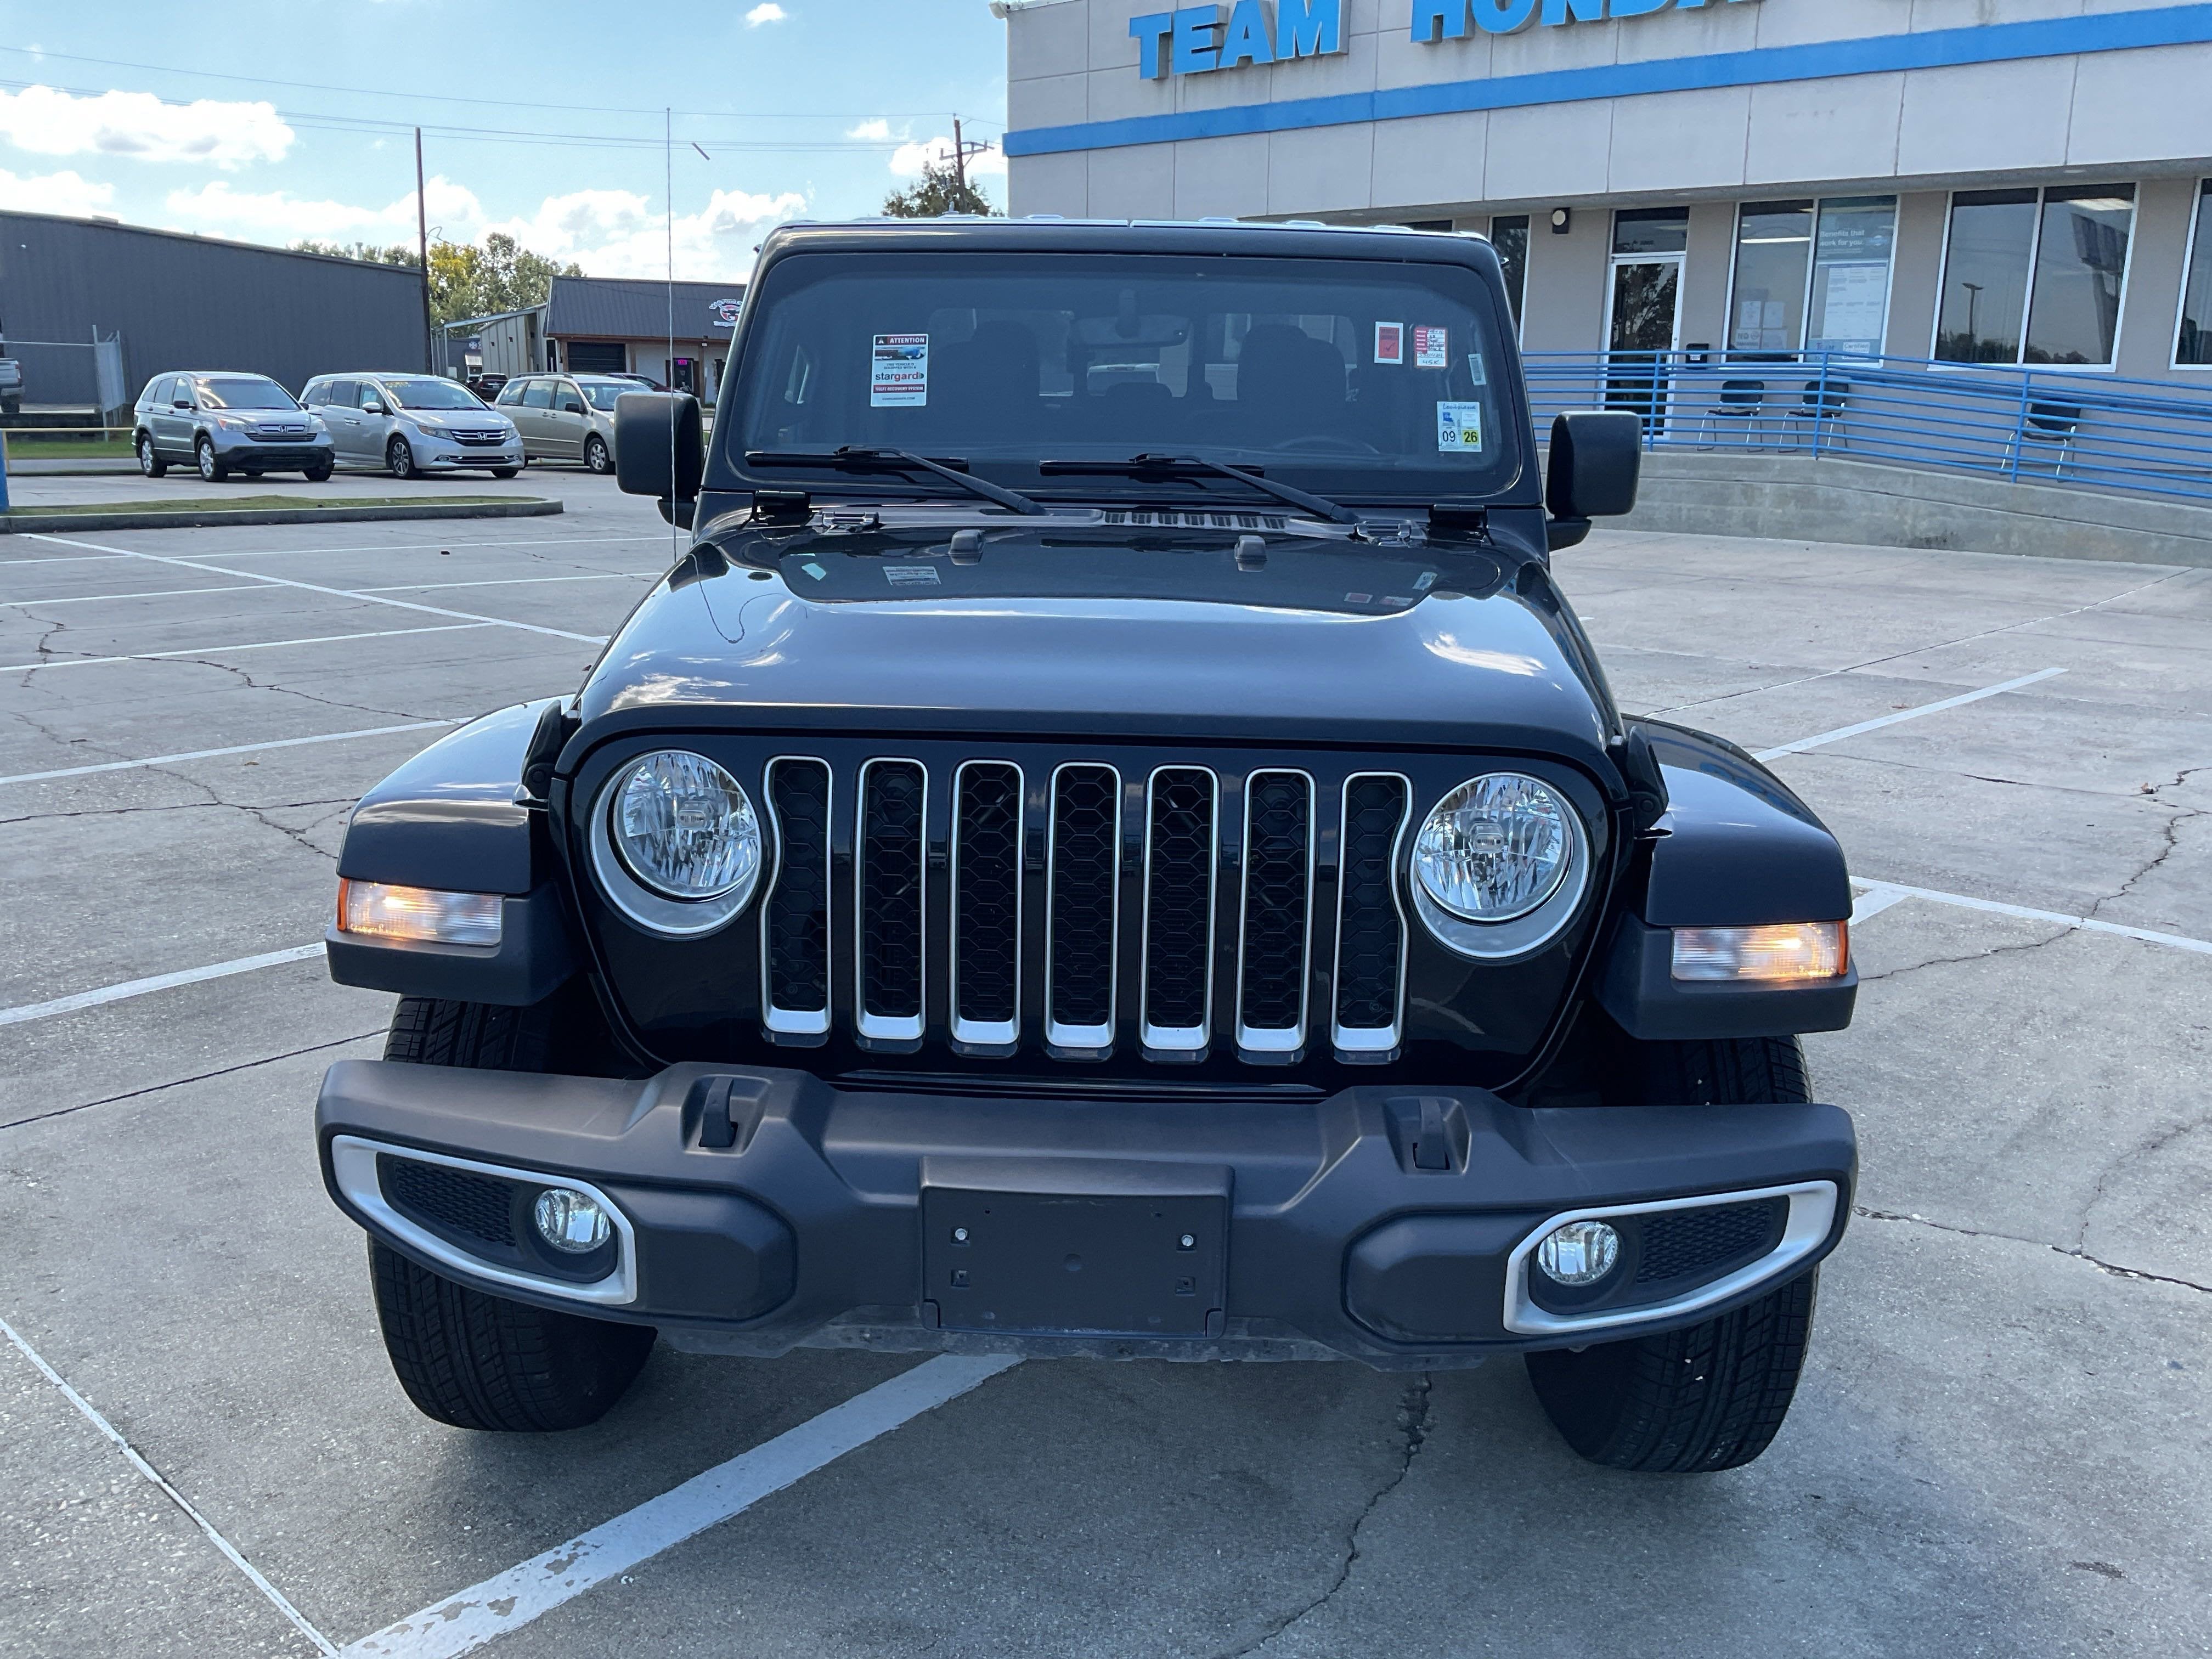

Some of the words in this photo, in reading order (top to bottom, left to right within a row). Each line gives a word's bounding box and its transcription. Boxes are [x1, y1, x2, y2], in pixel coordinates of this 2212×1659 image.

[1129, 0, 1344, 80] TEAM
[876, 371, 918, 382] stargard
[1442, 431, 1456, 442] 09
[1464, 431, 1477, 443] 26
